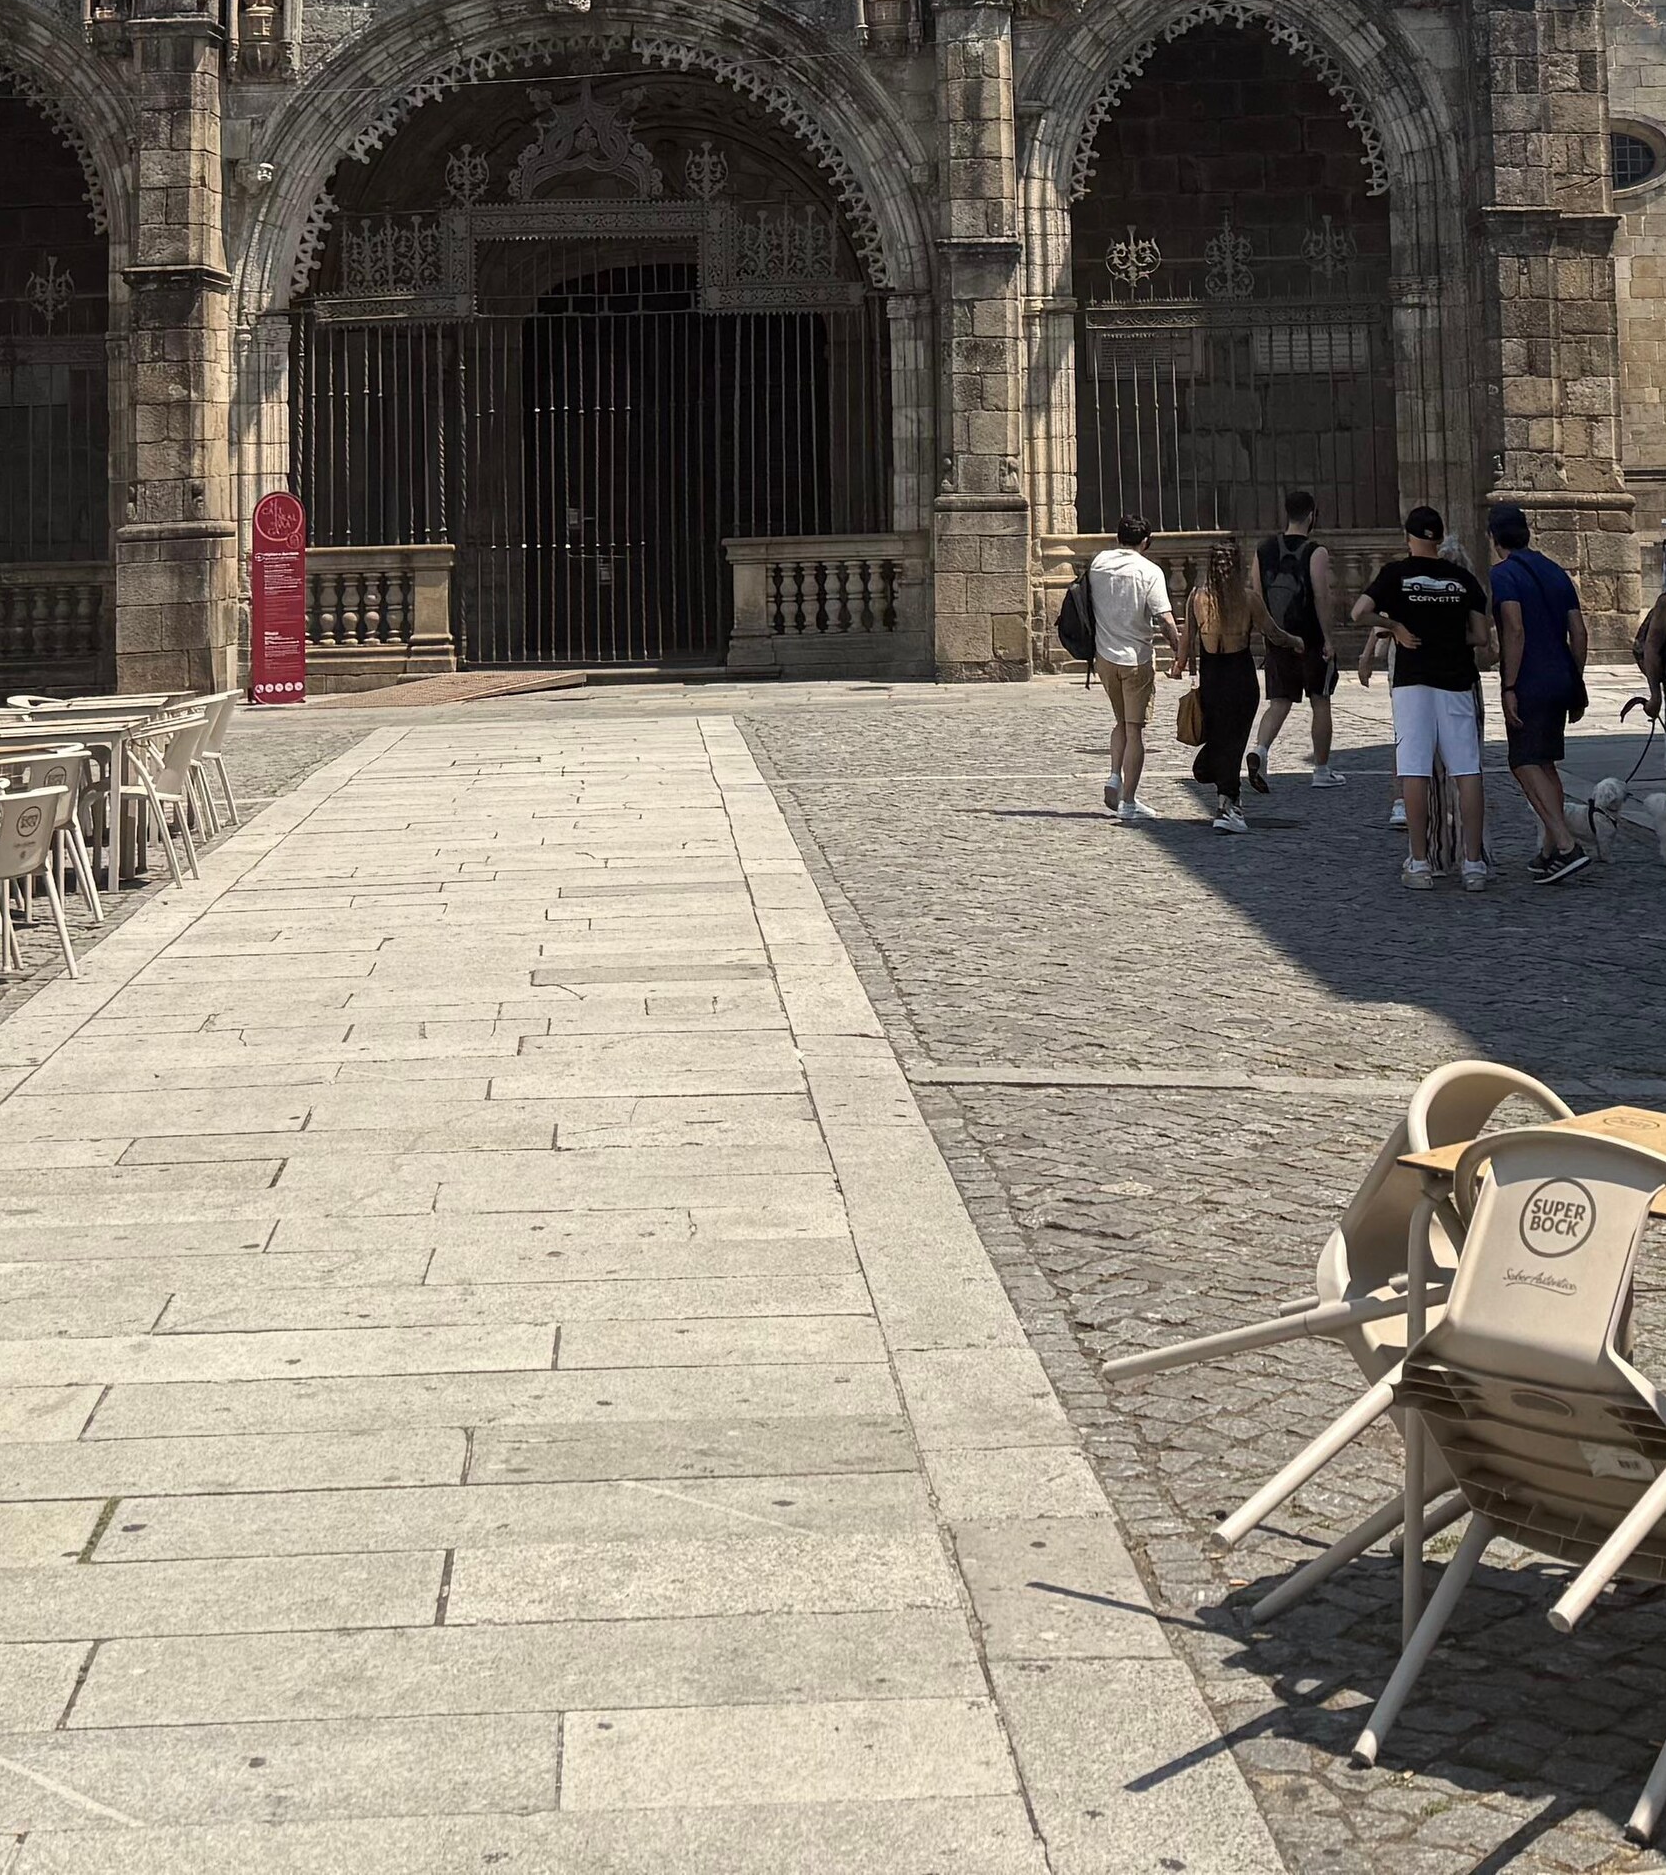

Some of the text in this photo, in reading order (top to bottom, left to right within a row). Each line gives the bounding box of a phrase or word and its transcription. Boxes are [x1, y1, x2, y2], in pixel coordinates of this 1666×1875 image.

[1408, 595, 1461, 603] CORVETTE
[1531, 1198, 1586, 1222] SUPER
[1529, 1215, 1580, 1237] BOCK
